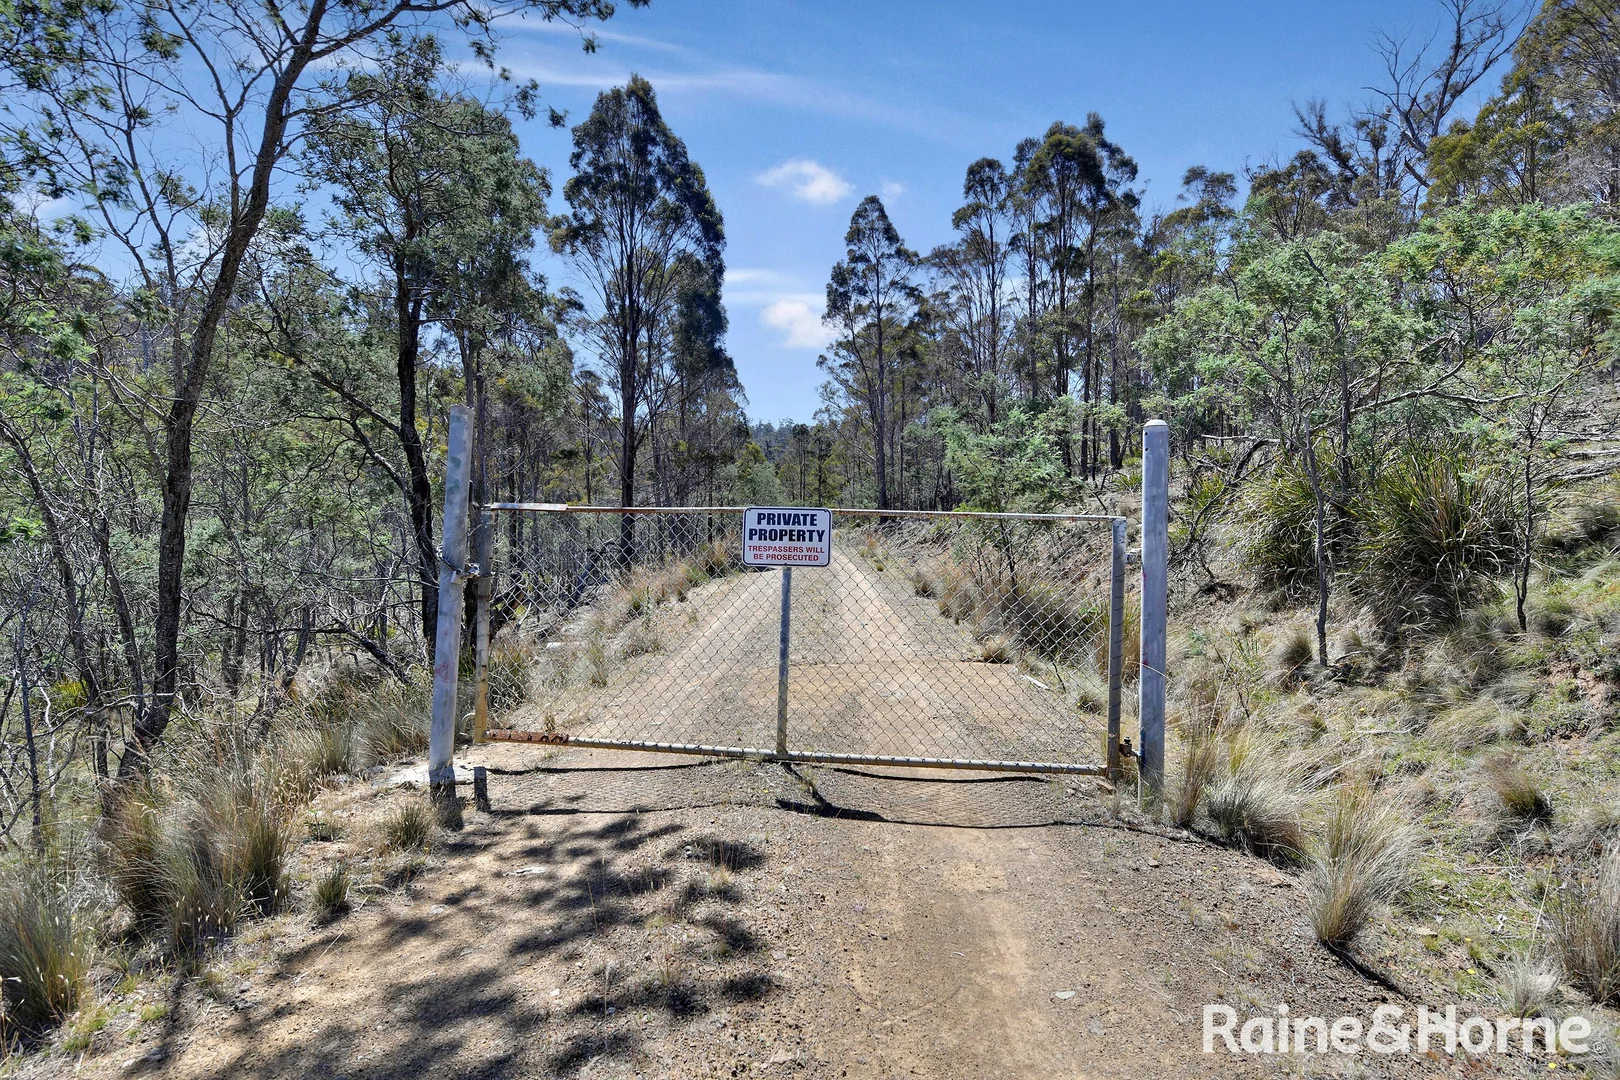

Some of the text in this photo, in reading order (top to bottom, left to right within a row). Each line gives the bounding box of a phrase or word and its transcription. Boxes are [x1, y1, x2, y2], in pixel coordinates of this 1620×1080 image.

[757, 513, 817, 526] PRIVATE
[749, 528, 825, 542] PROPERTY
[748, 545, 803, 553] TRESPASSERS
[766, 553, 819, 561] PROSECUTED
